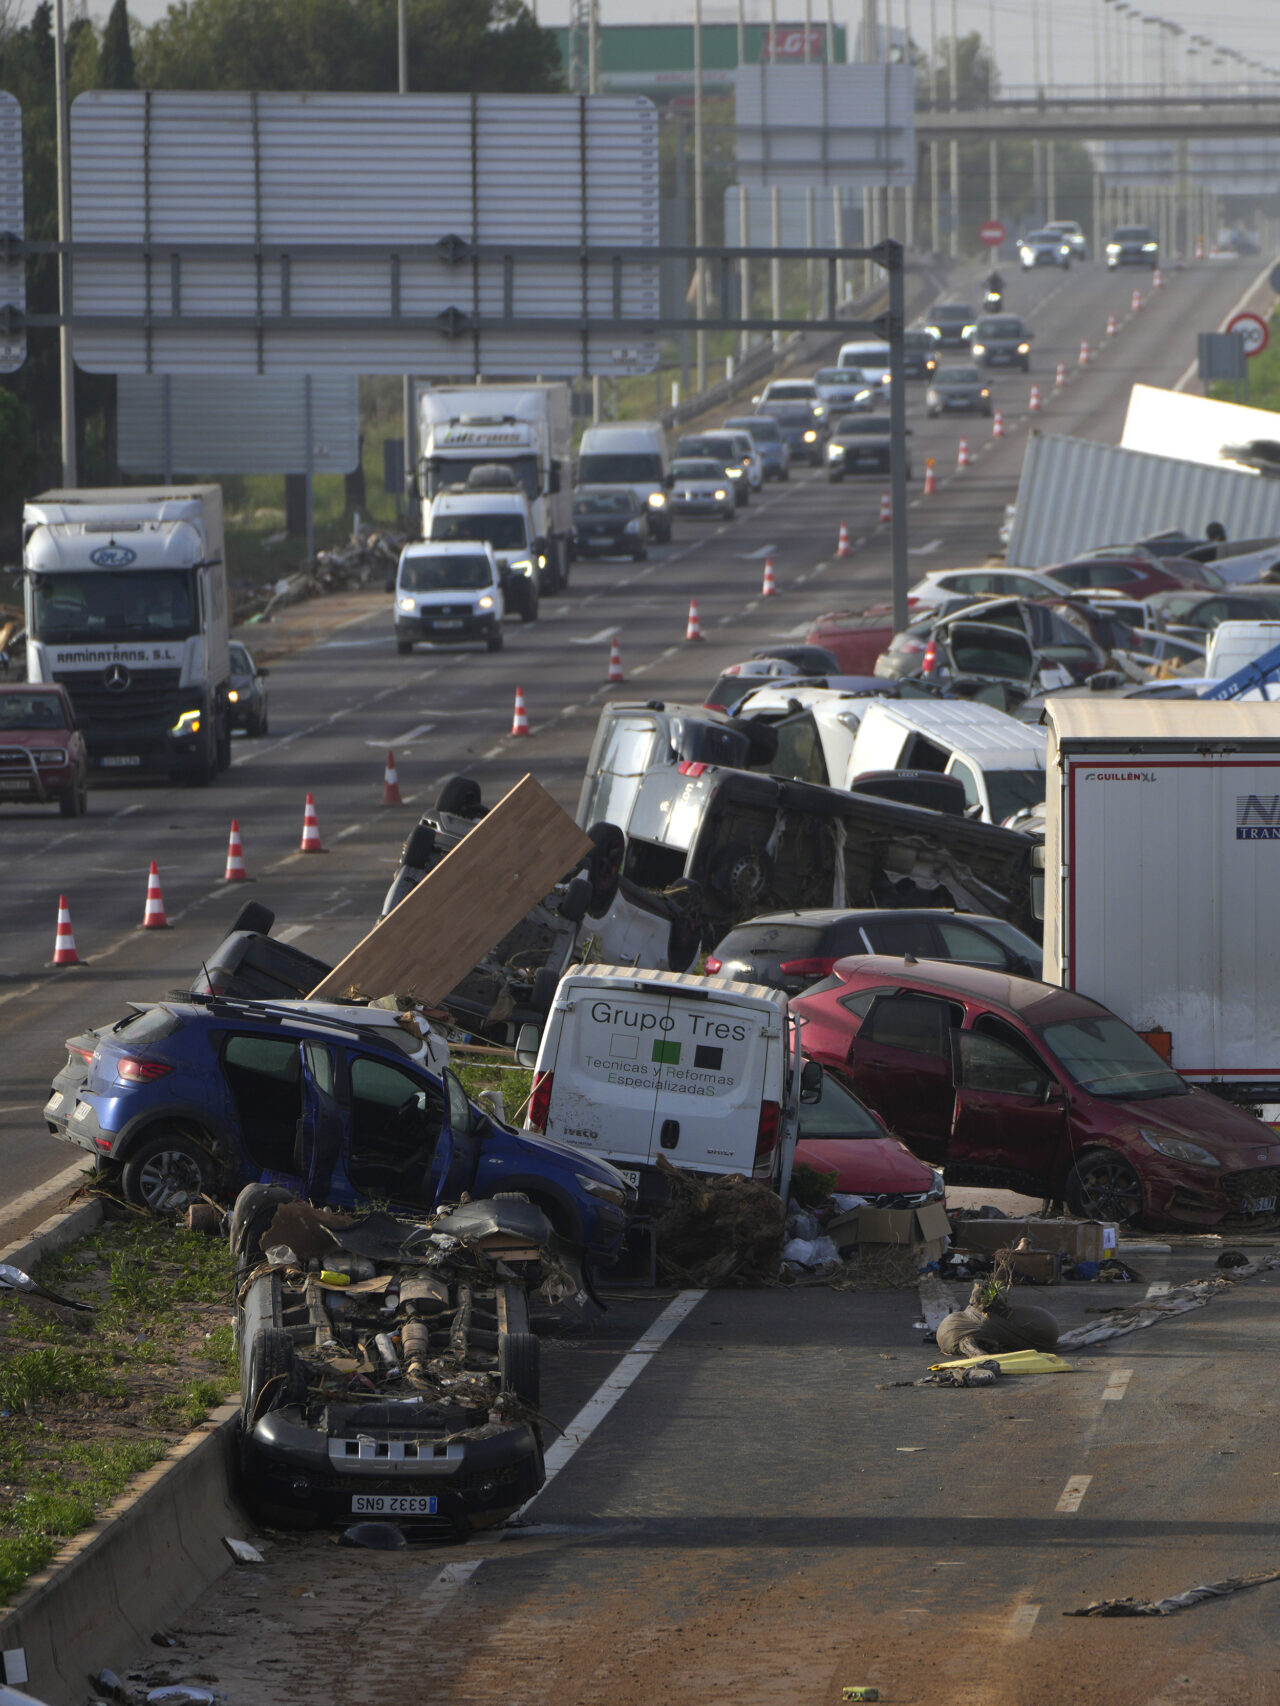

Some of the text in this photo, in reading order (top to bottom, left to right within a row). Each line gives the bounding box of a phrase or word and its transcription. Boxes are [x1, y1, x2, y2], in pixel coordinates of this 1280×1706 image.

[591, 1001, 746, 1042] Grupo Tres
[584, 1055, 735, 1087] Tecnicas y Reformas
[607, 1072, 716, 1098] EspecializadaS
[563, 1127, 599, 1140] IVECO
[356, 1497, 428, 1512] 6332 GNS
